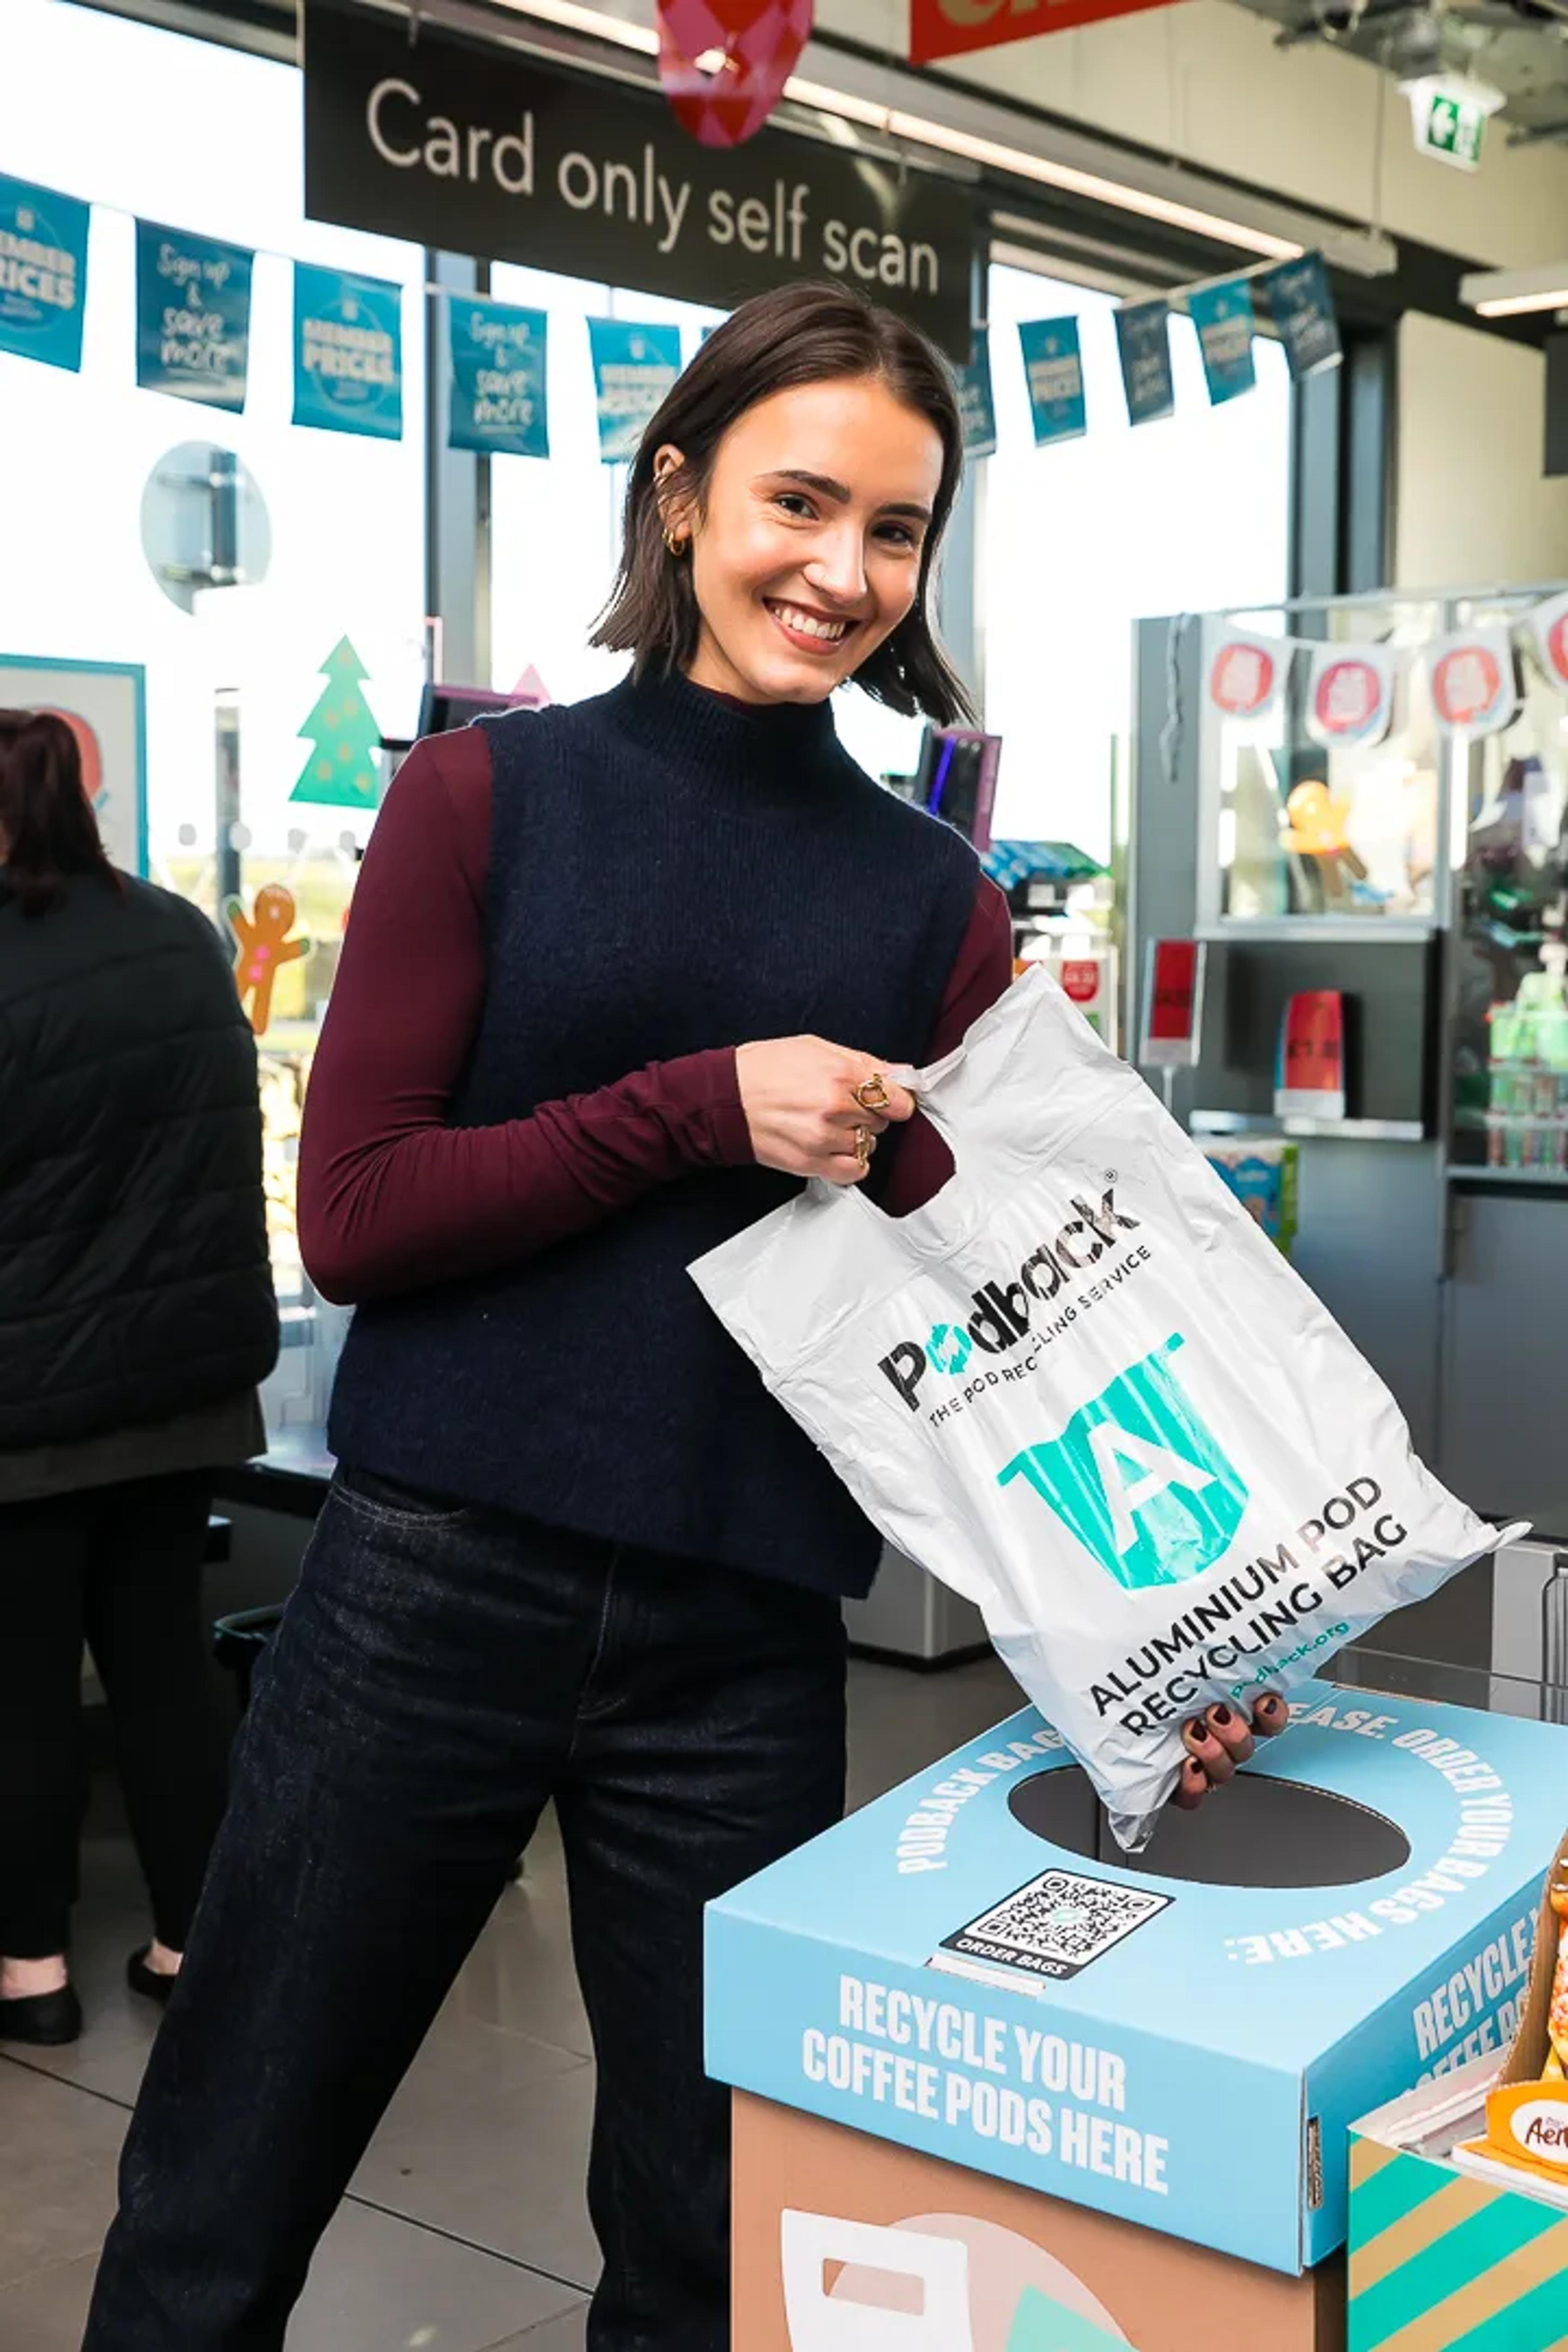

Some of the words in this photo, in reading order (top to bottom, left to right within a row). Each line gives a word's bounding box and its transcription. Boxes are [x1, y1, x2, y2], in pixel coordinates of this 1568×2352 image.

[366, 78, 534, 196] Card
[557, 144, 691, 253] only
[708, 180, 810, 261] self
[822, 219, 939, 294] scan
[929, 1398, 963, 1428] THE
[964, 1371, 999, 1404] POD
[1078, 1246, 1152, 1308] SERVICE
[1090, 1544, 1299, 1716] ALUMINIUM
[1296, 1477, 1382, 1554] POD
[1120, 1583, 1323, 1737] RECYCLING
[1321, 1515, 1408, 1590] BAG
[896, 1768, 999, 1874] PODBACK
[975, 1729, 1065, 1771] BAG
[1392, 1728, 1502, 1793] ORDER
[1448, 1793, 1513, 1857] YOUR
[956, 1937, 1018, 1963] ORDER
[1018, 1954, 1067, 1975] BAGS
[1224, 1912, 1383, 1966] HERE:
[1370, 1858, 1490, 1924] BAGS
[840, 1974, 1007, 2075] RECYCLE
[1014, 2025, 1125, 2111] YOUR
[1413, 1918, 1532, 2061] RECYCLE
[802, 2029, 939, 2120] COFFEE
[946, 2071, 1052, 2156] PODS
[1060, 2107, 1168, 2195] HERE
